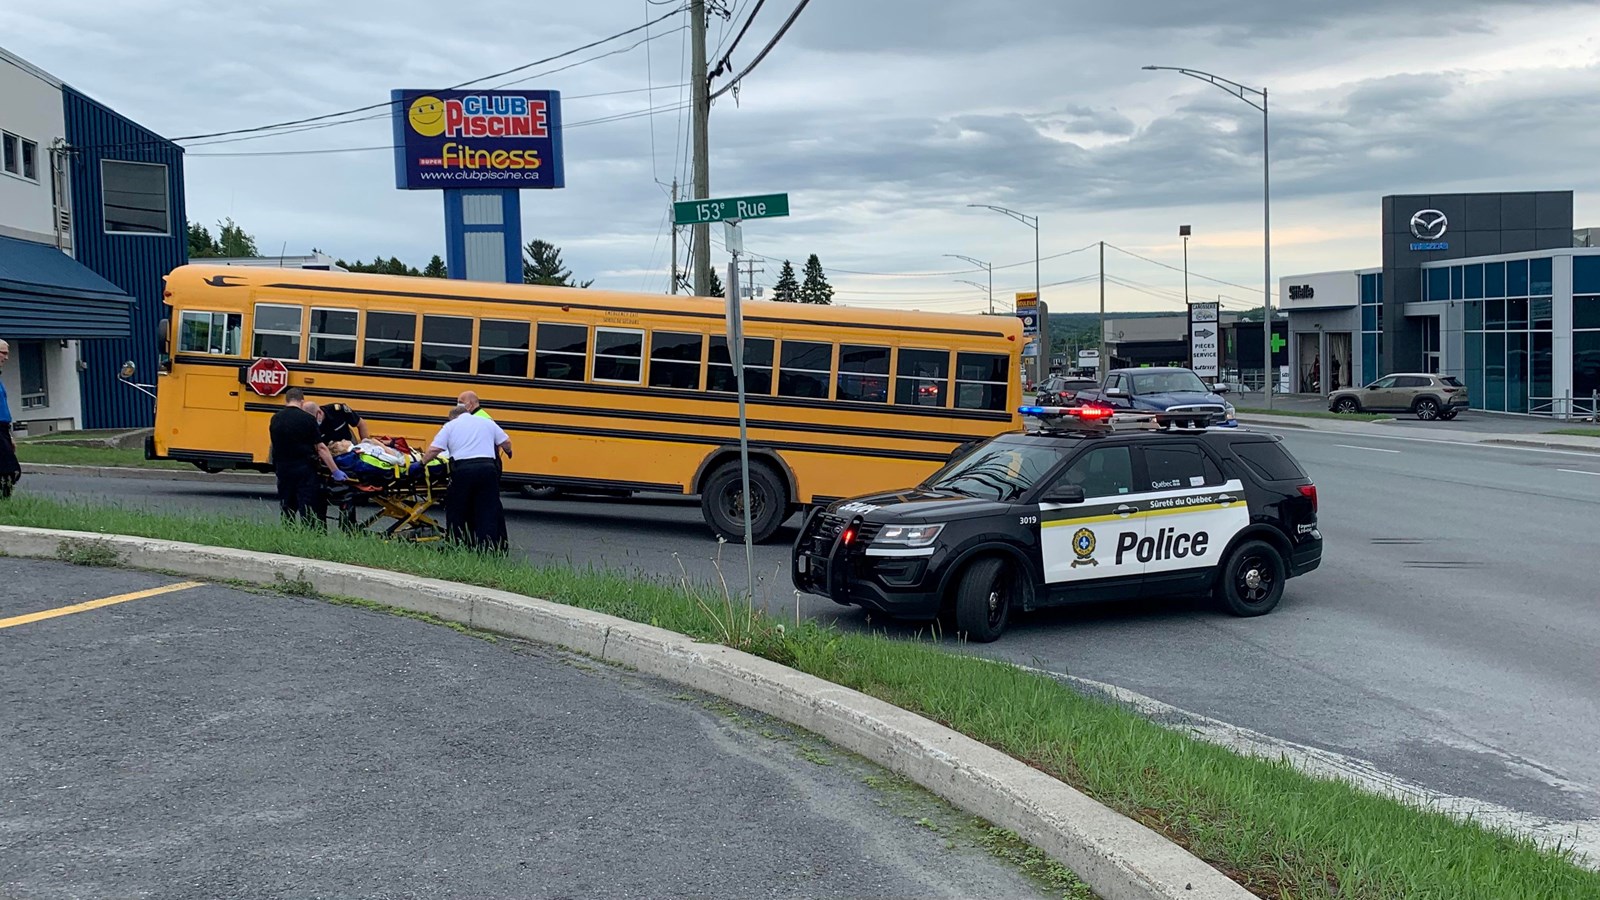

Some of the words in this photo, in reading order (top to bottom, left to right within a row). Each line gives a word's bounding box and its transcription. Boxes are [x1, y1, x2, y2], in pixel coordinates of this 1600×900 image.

[464, 96, 527, 116] CLUB
[445, 99, 548, 138] PISCINE
[420, 170, 540, 181] www.clubpiscine.ca
[737, 200, 767, 217] Rue
[251, 369, 286, 385] ARRET
[1151, 481, 1173, 489] Québec
[1150, 499, 1174, 509] Sûreté
[1175, 498, 1185, 506] du
[1186, 495, 1212, 505] Québec
[1019, 515, 1037, 525] 3019
[1115, 526, 1209, 565] Police
